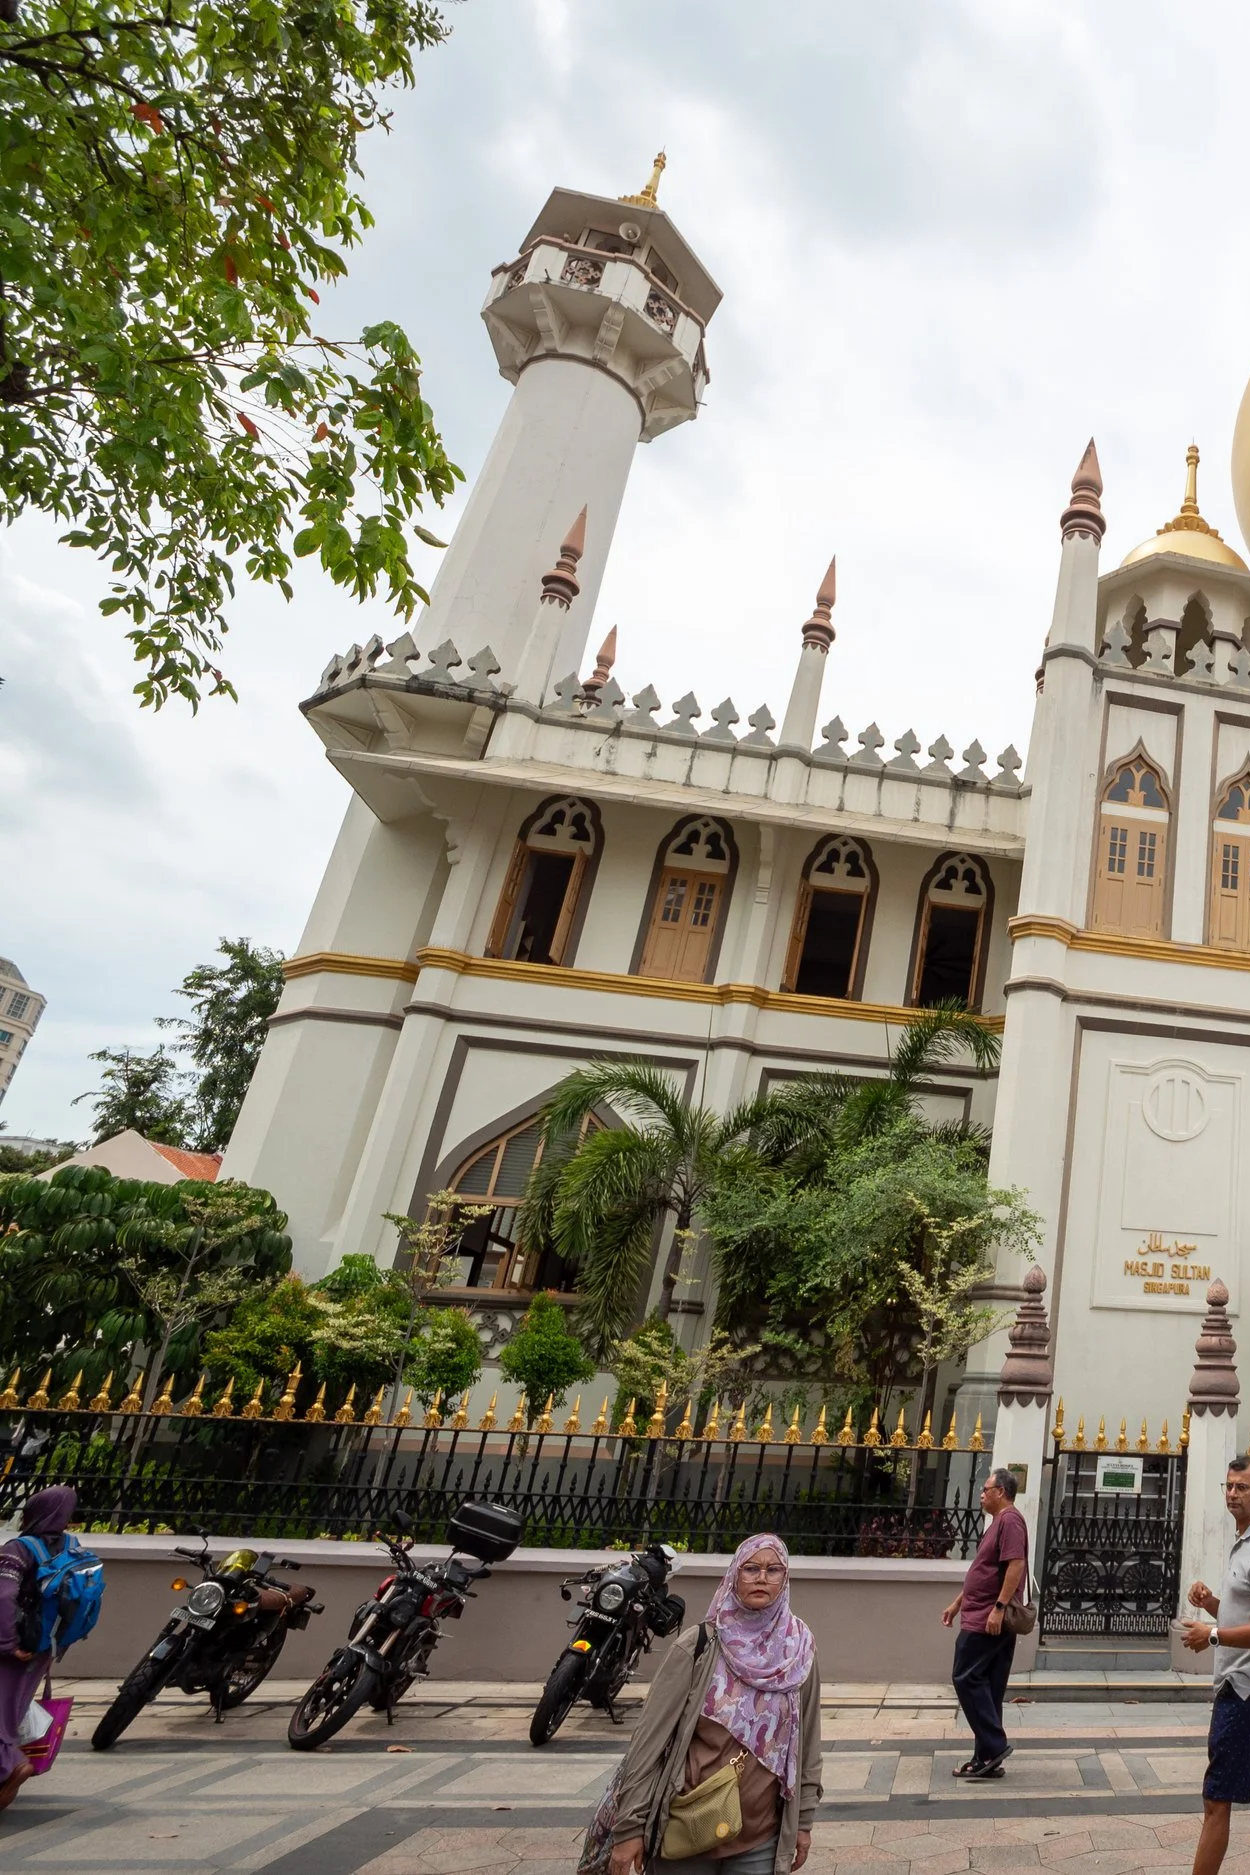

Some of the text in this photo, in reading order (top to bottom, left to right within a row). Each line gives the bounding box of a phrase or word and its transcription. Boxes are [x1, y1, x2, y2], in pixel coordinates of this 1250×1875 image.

[1124, 1260, 1211, 1281] MASJID SULTAN
[1143, 1281, 1190, 1296] SINGAPURA
